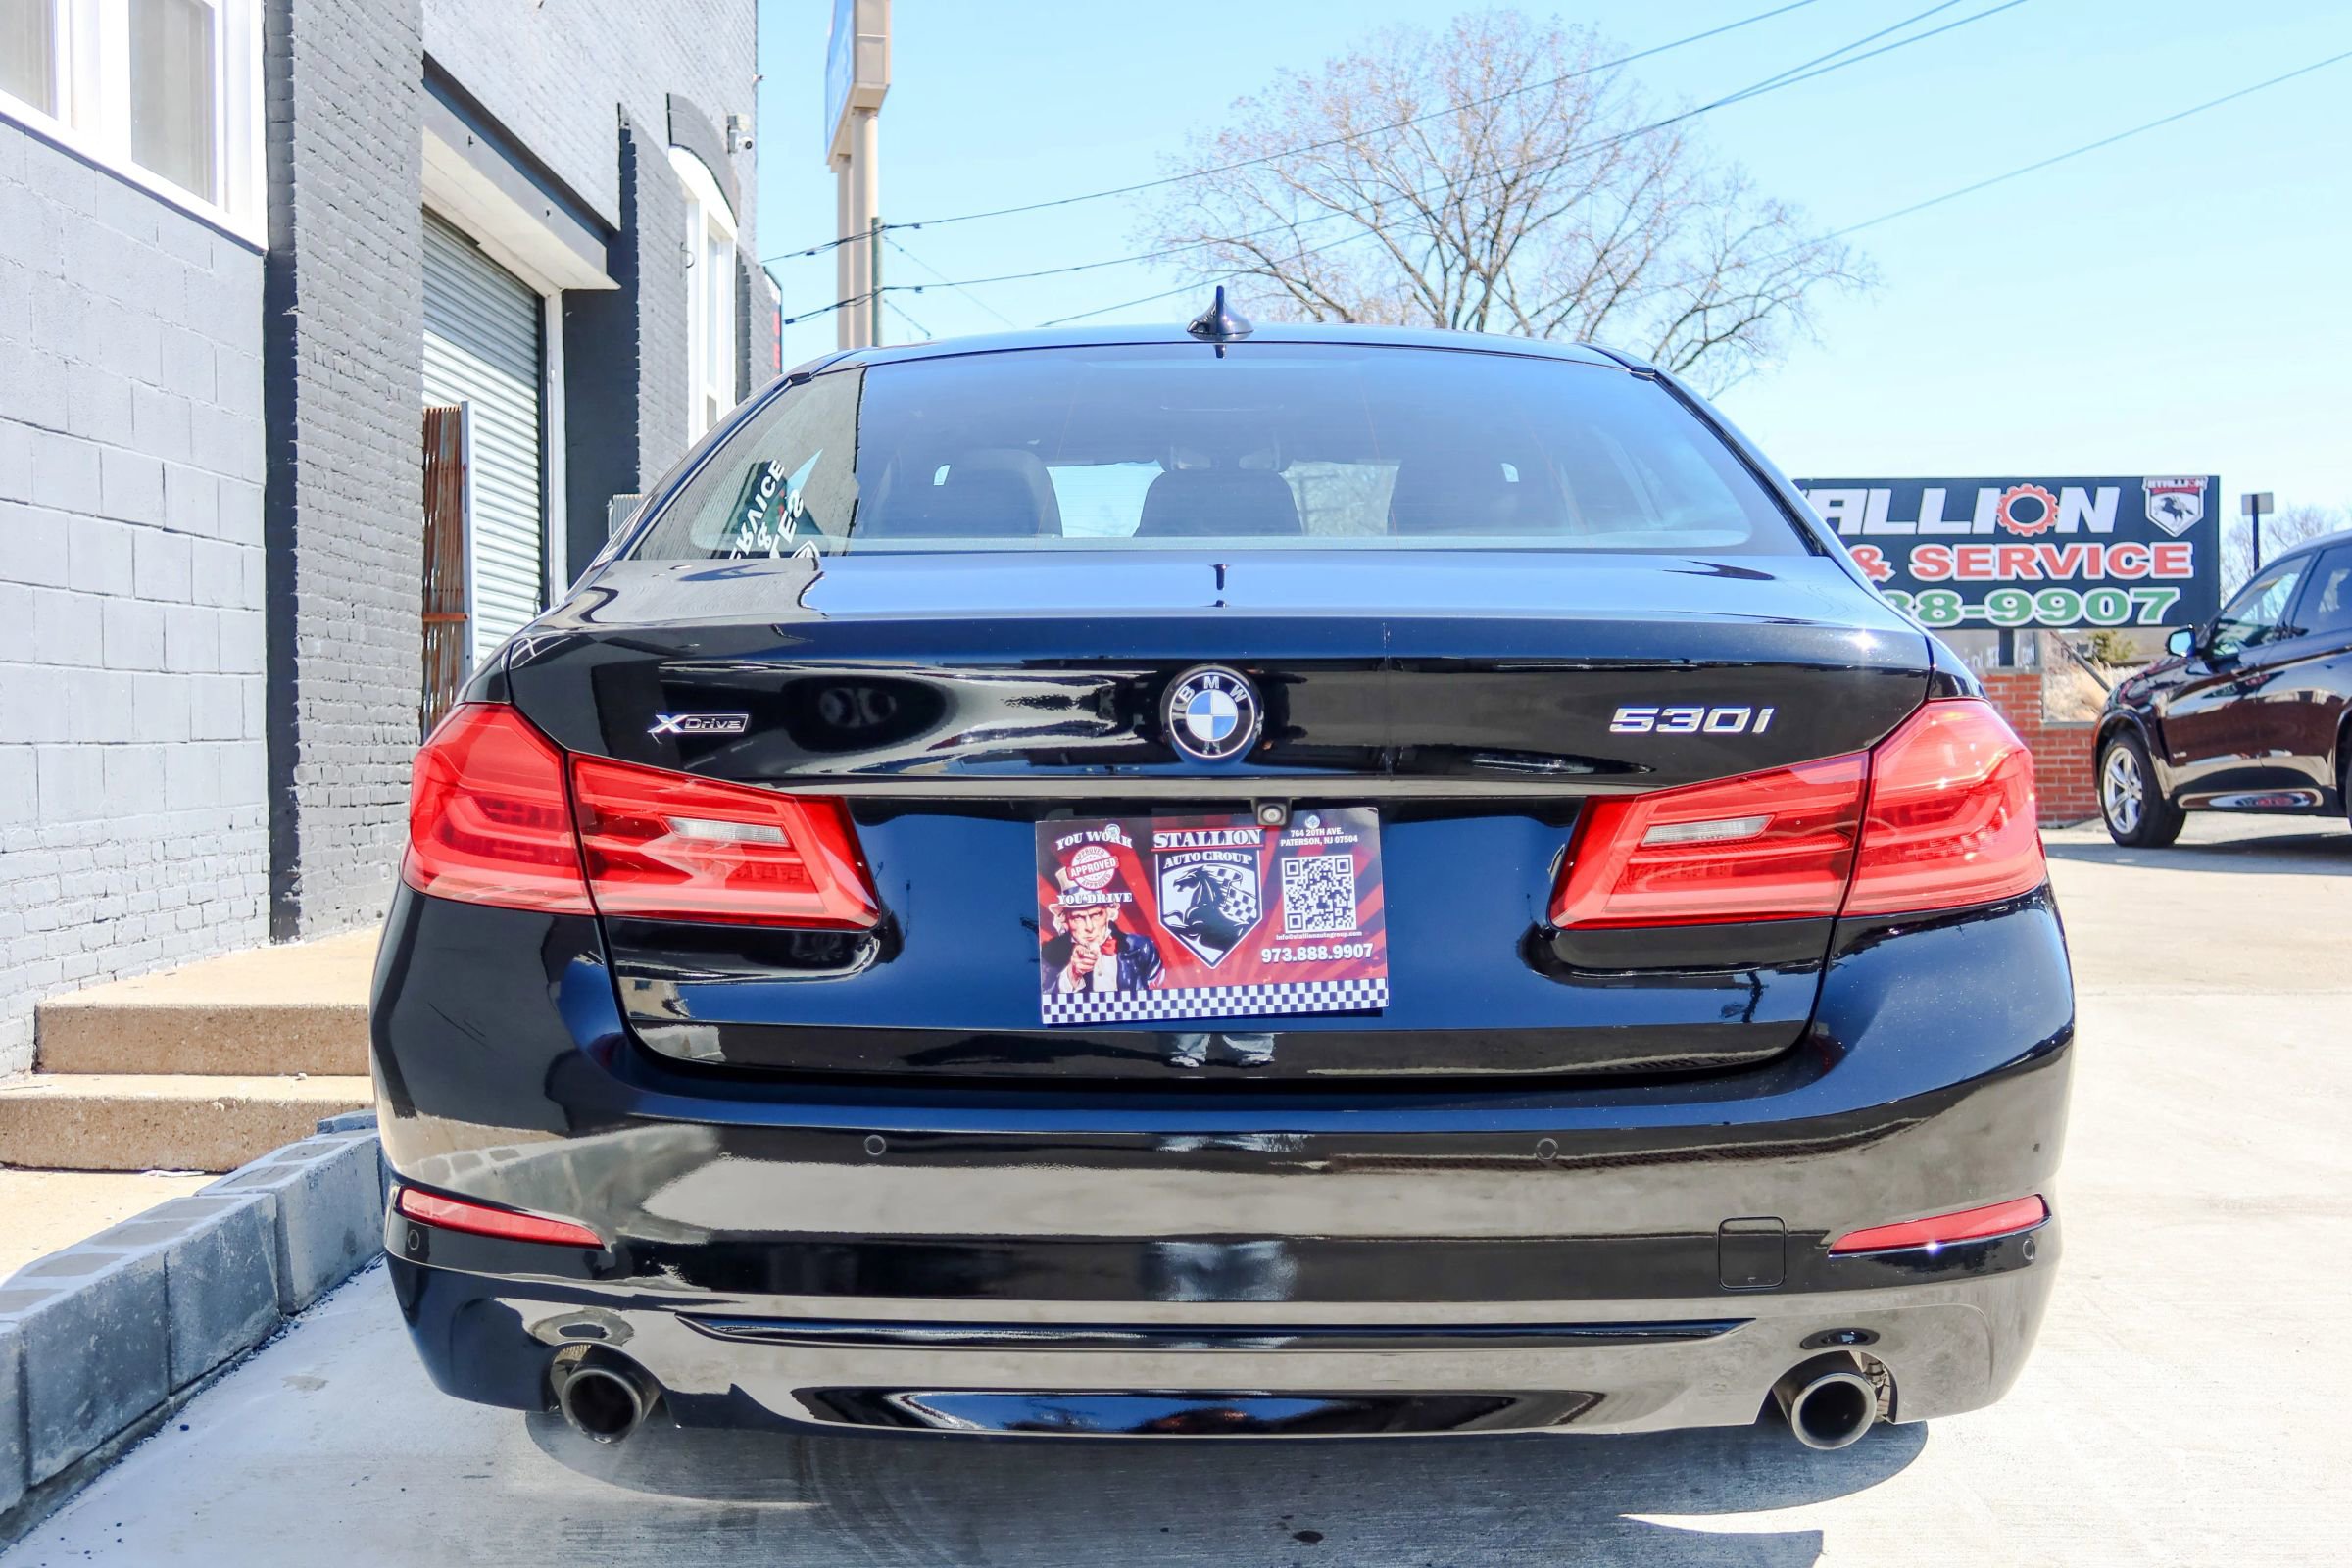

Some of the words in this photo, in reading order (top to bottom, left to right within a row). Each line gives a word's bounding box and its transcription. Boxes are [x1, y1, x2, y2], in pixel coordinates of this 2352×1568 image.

[1802, 484, 2121, 536] ALLION
[1909, 542, 2194, 581] SERVICE
[1178, 675, 1248, 704] BMW
[1055, 832, 1083, 851] YOU
[1153, 829, 1262, 848] STALLION
[1280, 837, 1322, 847] PATERSON,
[1324, 836, 1333, 845] NJ
[1076, 846, 1106, 861] APPROVED
[1163, 852, 1200, 869] AUTO
[1202, 851, 1253, 864] GROUP
[1070, 857, 1117, 878] APPROVED
[1057, 893, 1084, 905] YOU
[1086, 892, 1133, 904] DRIVE
[1261, 943, 1373, 963] 973.888.9907
